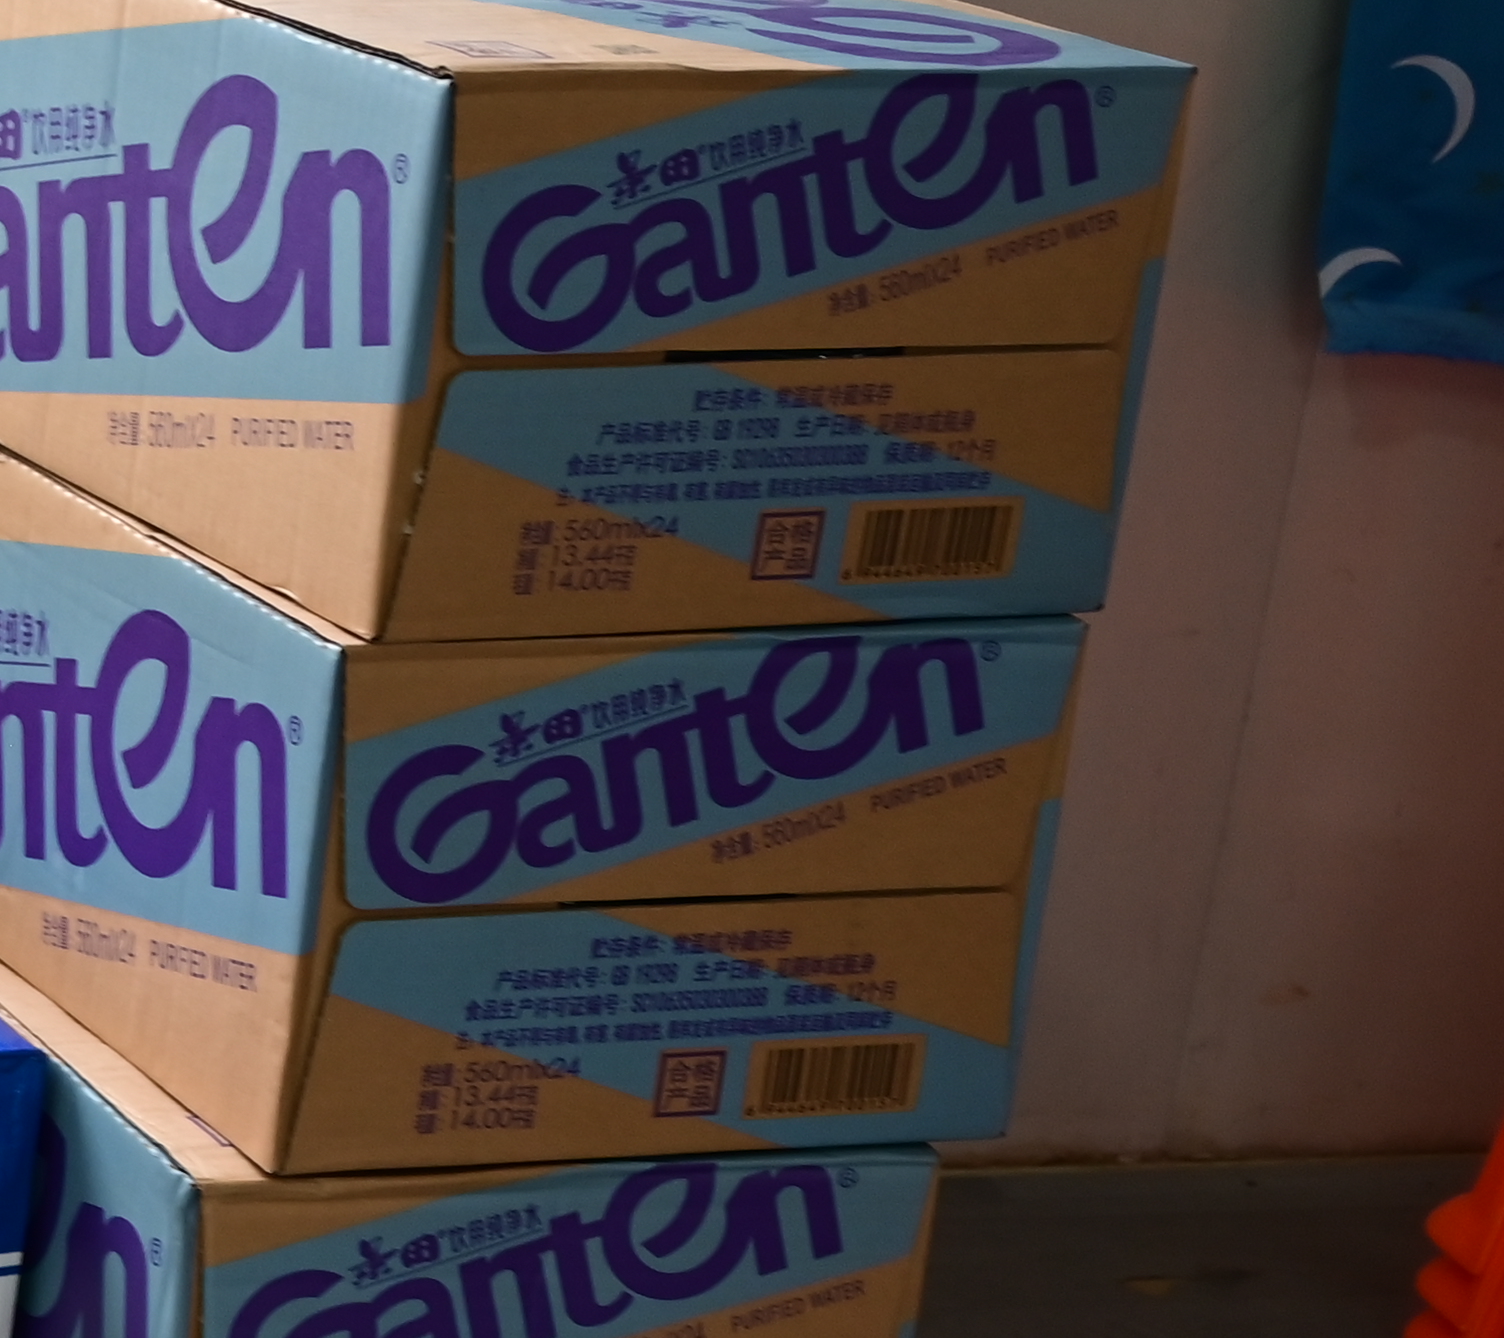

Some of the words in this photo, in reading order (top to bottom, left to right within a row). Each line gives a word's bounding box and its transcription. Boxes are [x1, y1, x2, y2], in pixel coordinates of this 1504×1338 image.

[30, 102, 119, 160] 饮用纯净水
[707, 118, 806, 168] 饮用纯净水
[481, 71, 1099, 353] Ganten
[986, 227, 1061, 267] PURIFIED
[1063, 209, 1119, 241] WATER
[231, 416, 299, 451] PURIFIED
[302, 419, 356, 452] WATER
[366, 635, 985, 905] Ganten
[869, 775, 947, 813] PURIFIED
[949, 757, 1008, 789] WATER
[731, 1297, 806, 1333] PURIFIED
[808, 1279, 866, 1308] WATER
